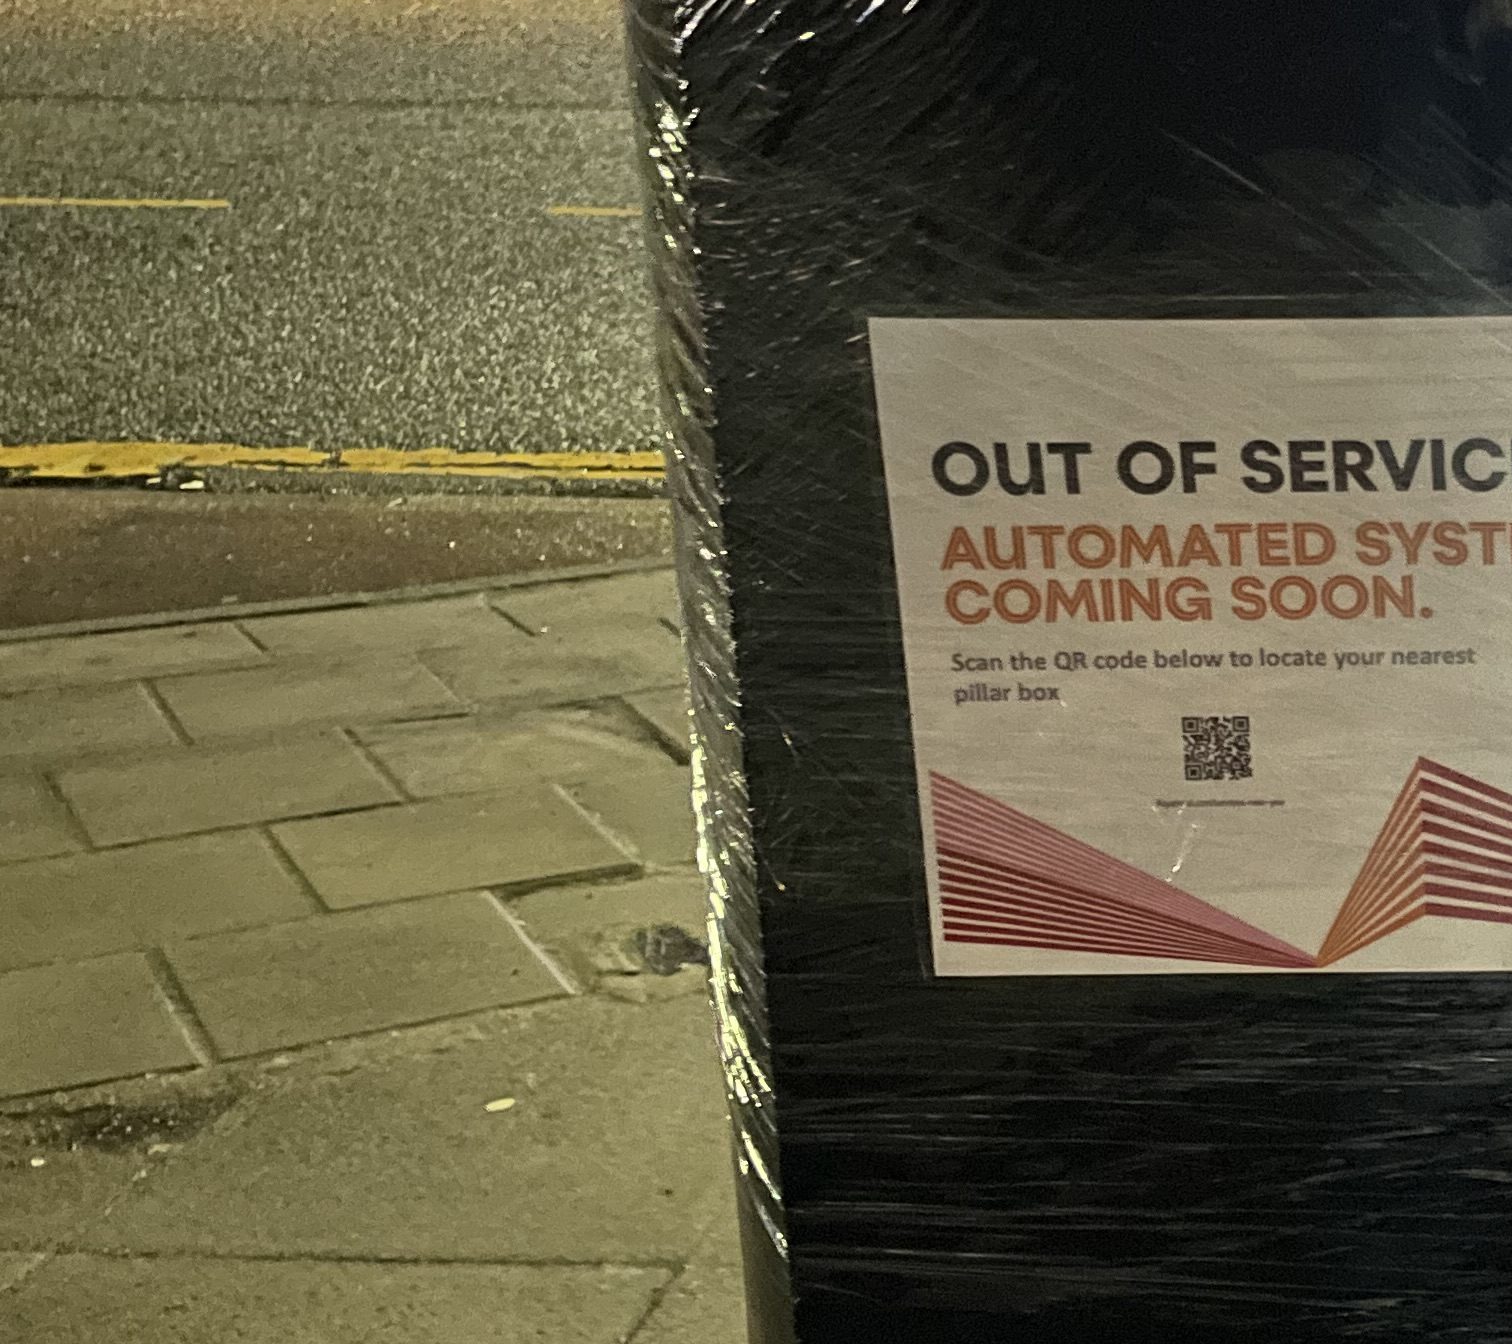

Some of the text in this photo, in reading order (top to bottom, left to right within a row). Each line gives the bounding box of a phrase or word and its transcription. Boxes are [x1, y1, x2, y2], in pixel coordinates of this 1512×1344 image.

[931, 441, 1093, 497] OUT
[1116, 439, 1218, 495] OF
[939, 521, 1337, 571] AUTOMATED
[944, 574, 1434, 625] COMING SOON.
[951, 647, 1477, 672] Scan the QR code below to locate your nearest
[953, 683, 1061, 705] pillar box
